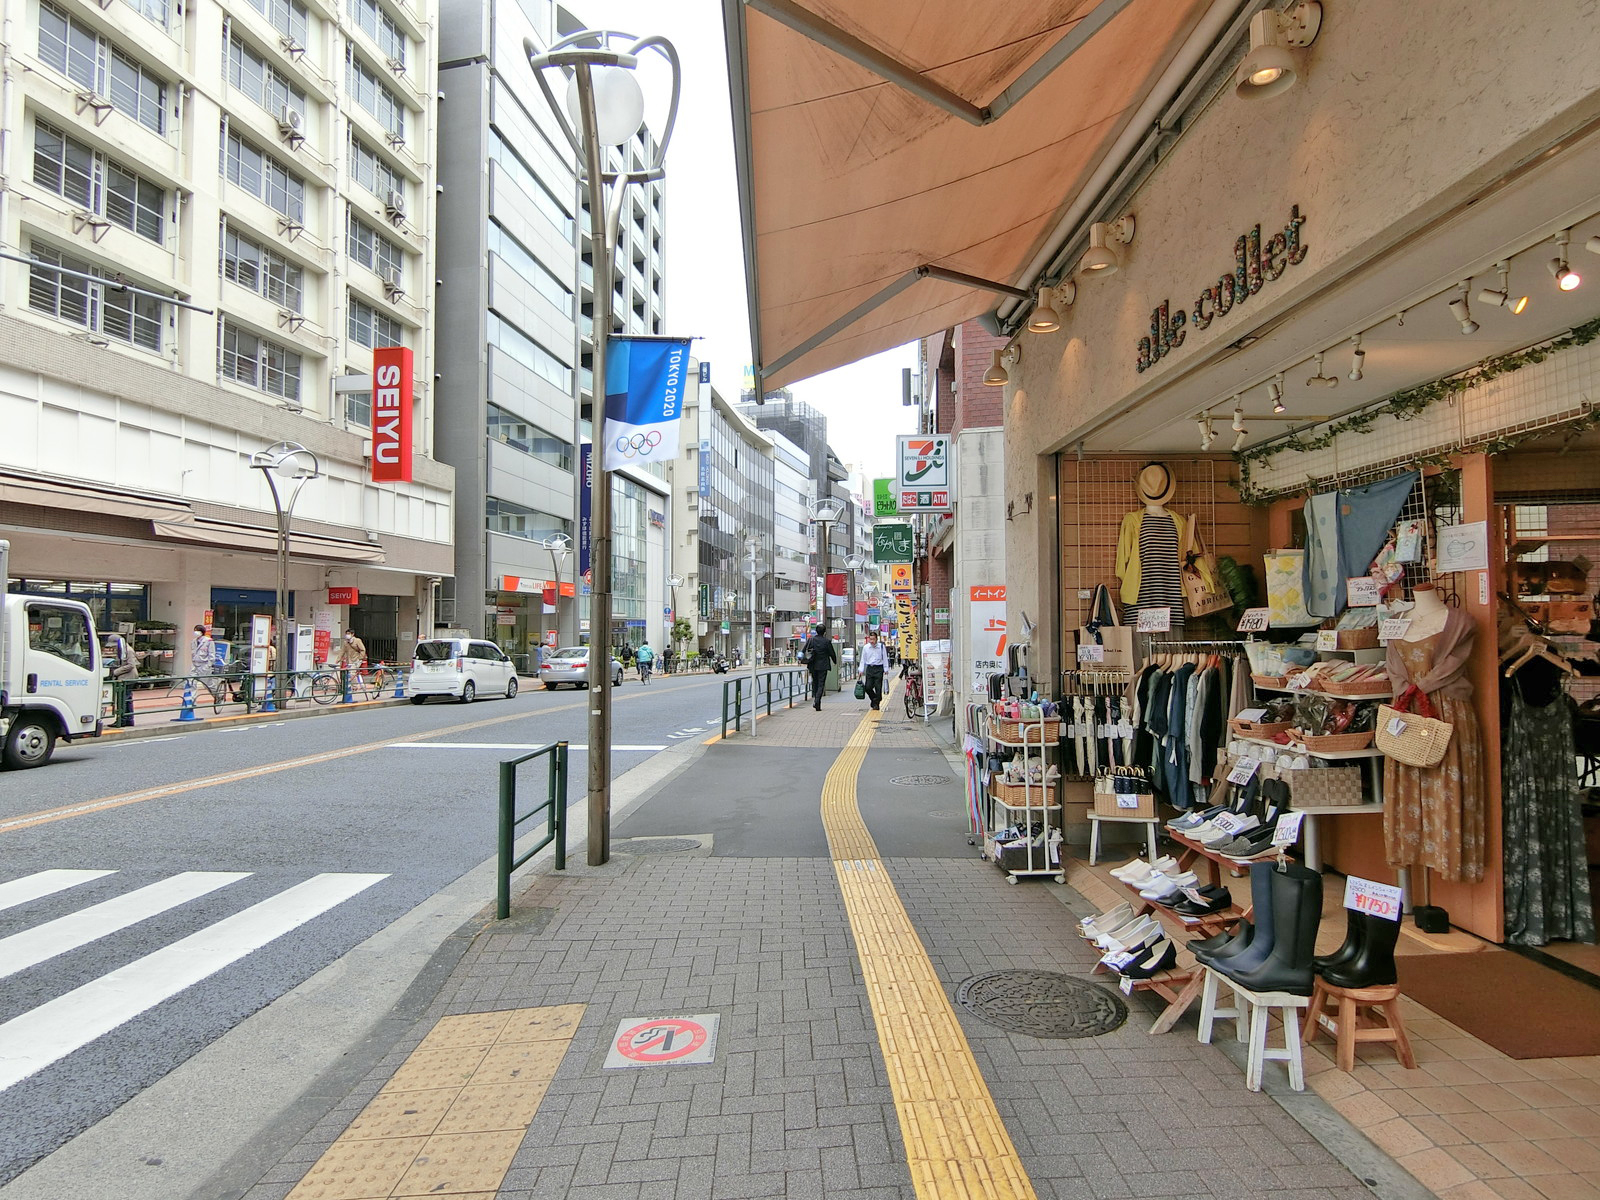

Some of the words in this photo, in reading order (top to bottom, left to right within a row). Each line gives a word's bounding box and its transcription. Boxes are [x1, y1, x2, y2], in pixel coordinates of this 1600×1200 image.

[1192, 203, 1309, 331] collet
[666, 349, 683, 387] TOKYO
[376, 365, 401, 464] SEIYU
[662, 388, 677, 417] 2020
[902, 494, 917, 504] たばこ
[919, 494, 930, 504] 酒
[933, 494, 947, 504] ATM
[1355, 892, 1391, 914] ¥1750
